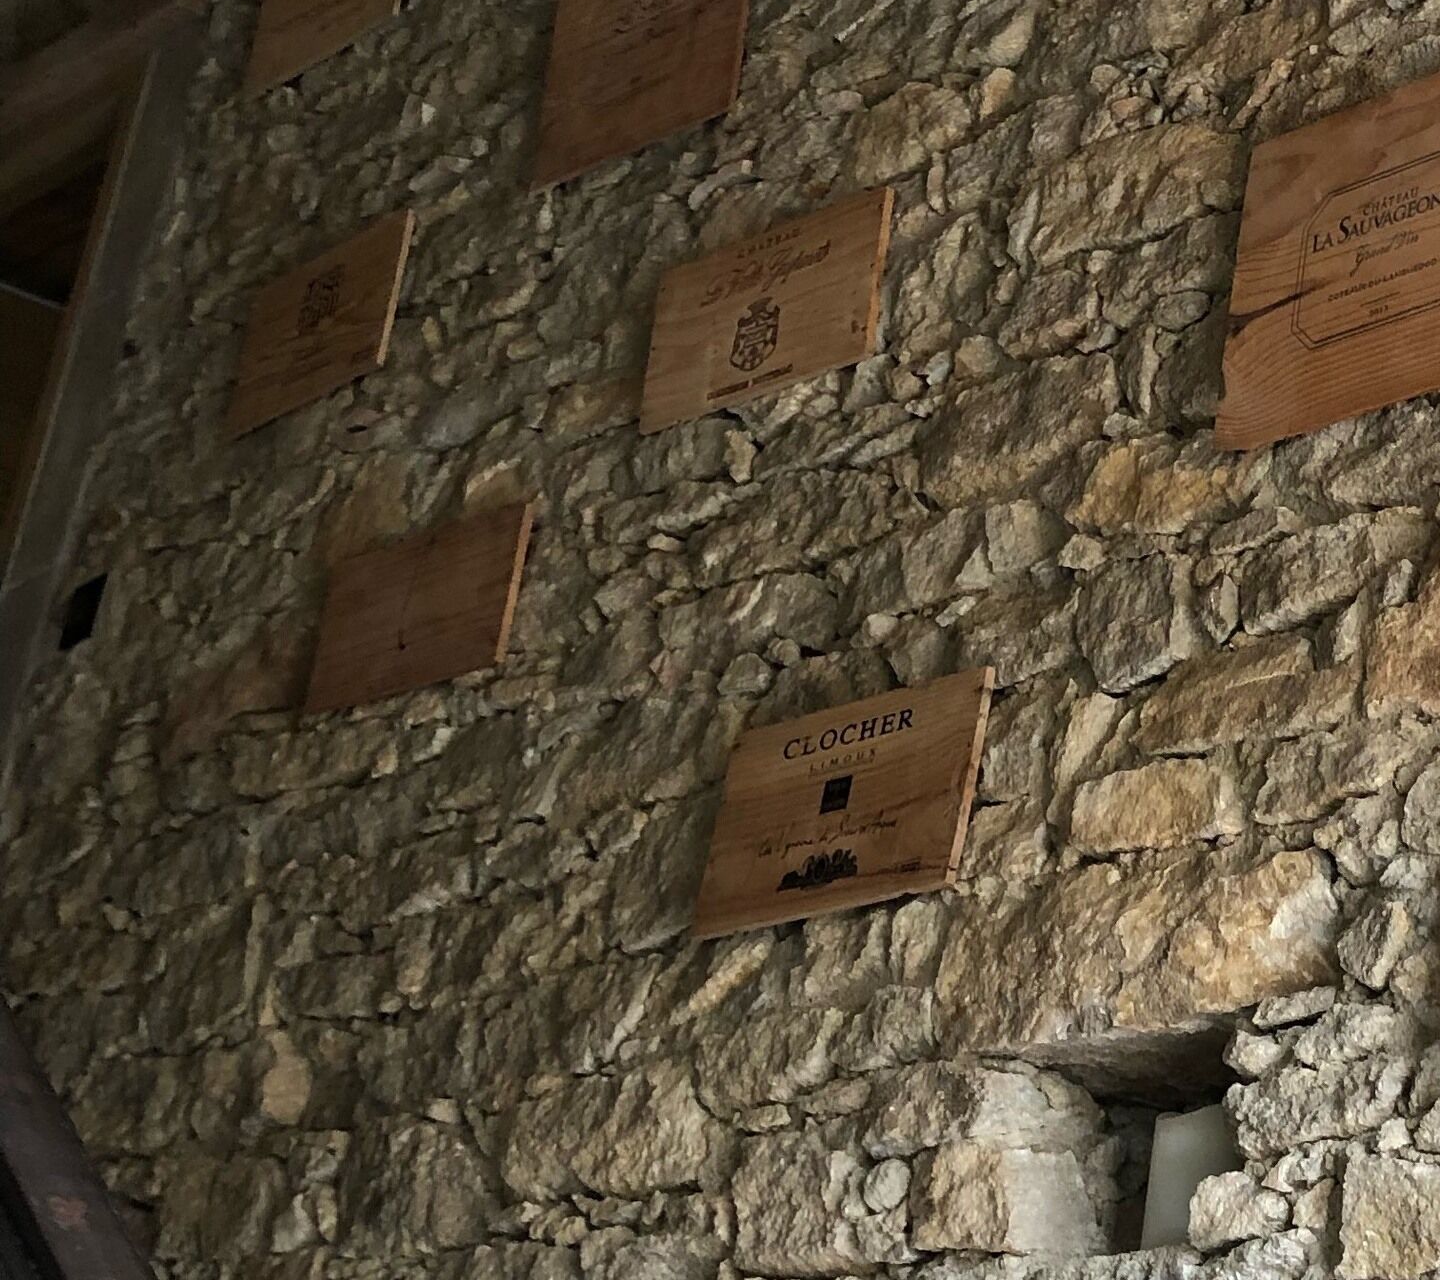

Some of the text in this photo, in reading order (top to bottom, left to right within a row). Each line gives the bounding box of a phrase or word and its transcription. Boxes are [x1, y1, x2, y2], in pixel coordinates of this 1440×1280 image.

[1312, 232, 1335, 254] LA
[783, 708, 913, 760] CLOCHER
[808, 747, 877, 774] LIMOUX
